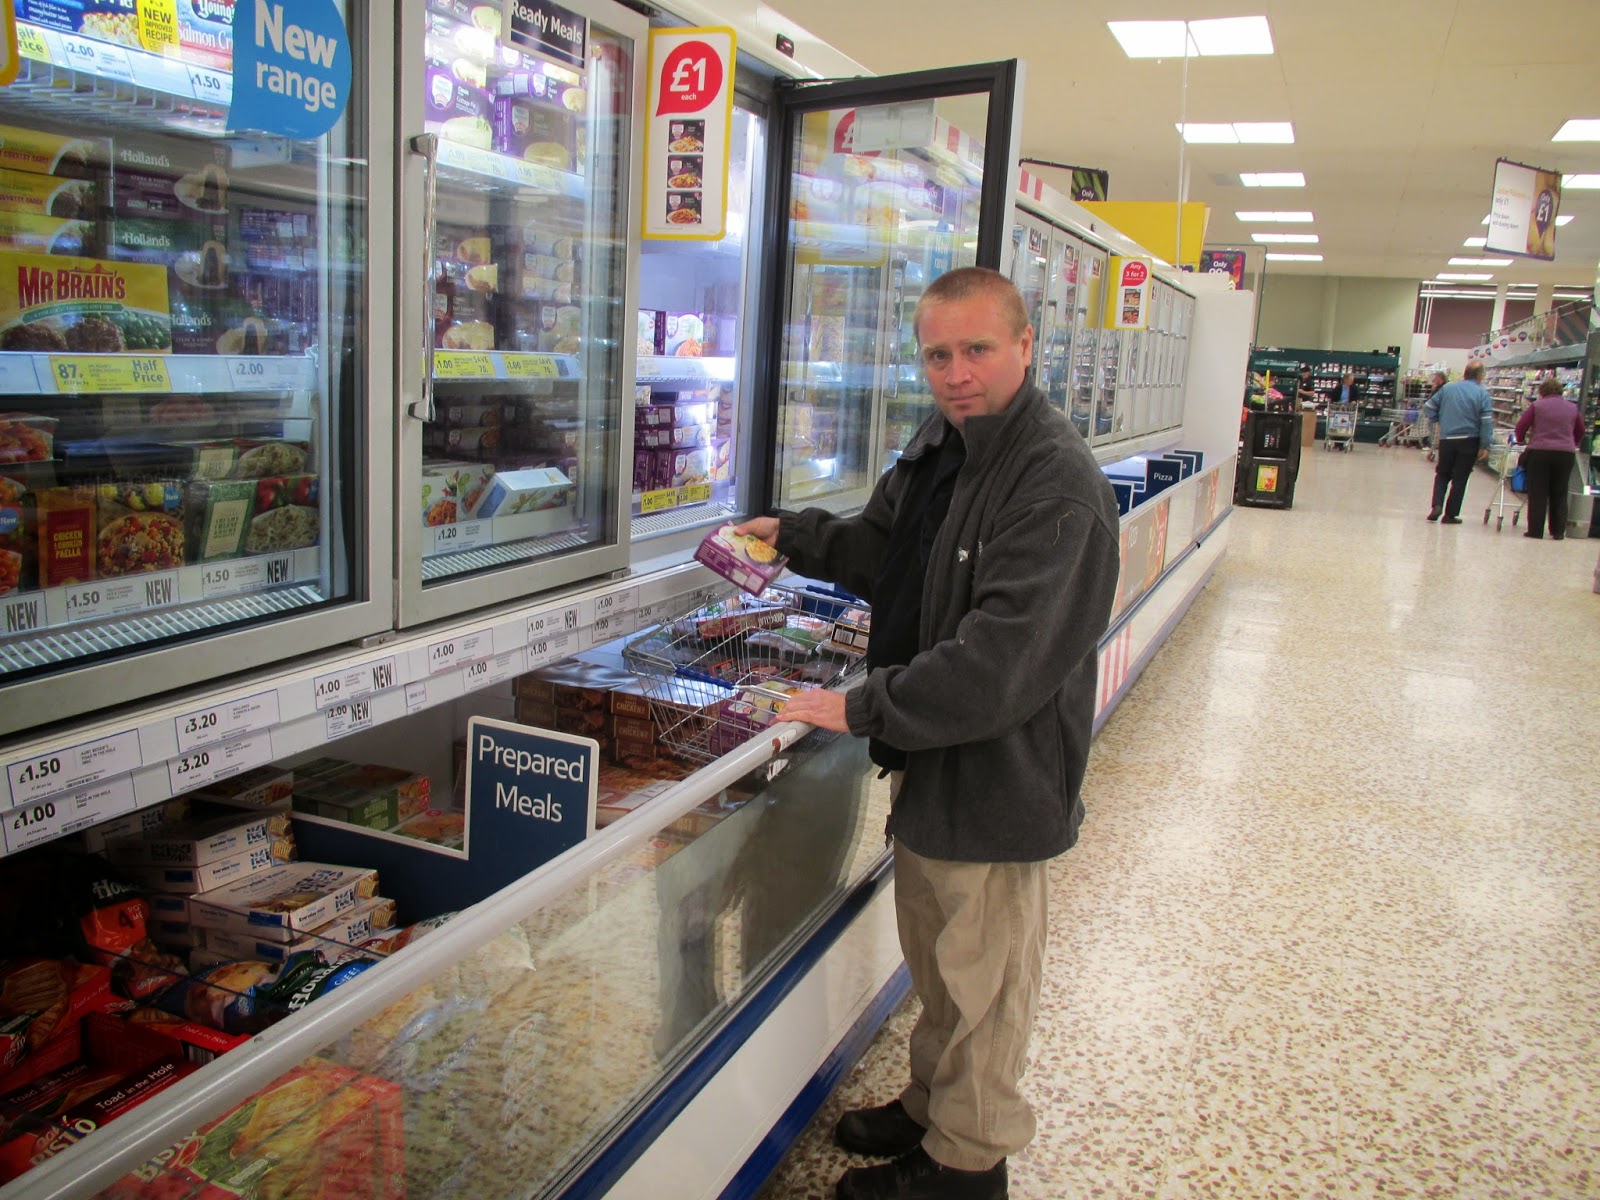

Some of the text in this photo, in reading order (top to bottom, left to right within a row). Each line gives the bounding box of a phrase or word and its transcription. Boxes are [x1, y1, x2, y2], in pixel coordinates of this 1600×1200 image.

[144, 8, 172, 24] NEW
[197, 0, 234, 23] Young's
[145, 20, 173, 33] IMPROVED
[511, 0, 583, 45] Ready Meals
[18, 26, 36, 40] alf
[145, 28, 173, 44] RECIPE
[178, 20, 216, 48] Salmon
[255, 0, 337, 69] New
[18, 38, 44, 54] rice
[67, 42, 95, 58] £2.00
[193, 73, 221, 91] £1.50
[669, 57, 707, 92] £1
[256, 61, 336, 112] range
[121, 150, 170, 168] Holland's
[1082, 189, 1095, 200] Only
[1536, 203, 1550, 222] £1
[122, 232, 171, 248] Holland's
[1130, 263, 1142, 271] Any
[1213, 261, 1228, 269] Only
[18, 266, 126, 310] MR BRAIN'S
[133, 359, 158, 374] Half
[236, 363, 264, 376] £2.00
[133, 372, 163, 384] Price
[1154, 472, 1173, 482] Pizza
[54, 529, 83, 542] CHICKEN
[438, 527, 457, 540] £1.20
[55, 550, 82, 561] PAELLA
[202, 568, 230, 586] £1.50
[267, 558, 289, 585] NEW
[67, 590, 100, 609] £1.50
[146, 577, 172, 607] NEW
[6, 599, 38, 633] NEW
[528, 609, 578, 633] £1.00 NEW
[433, 643, 455, 660] £1.00
[530, 642, 548, 657] £1.00
[468, 662, 488, 678] £1.00
[316, 663, 392, 697] £1.00 NEW
[327, 700, 369, 722] £2.00 NEW
[185, 712, 217, 734] £3.20
[178, 752, 210, 775] £3.20
[479, 734, 585, 783] Prepared
[19, 757, 61, 784] £1.50
[495, 782, 563, 823] Meals
[14, 802, 56, 830] £1.00
[95, 1090, 126, 1111] Toad
[134, 1073, 151, 1089] the
[147, 1062, 175, 1080] Hole
